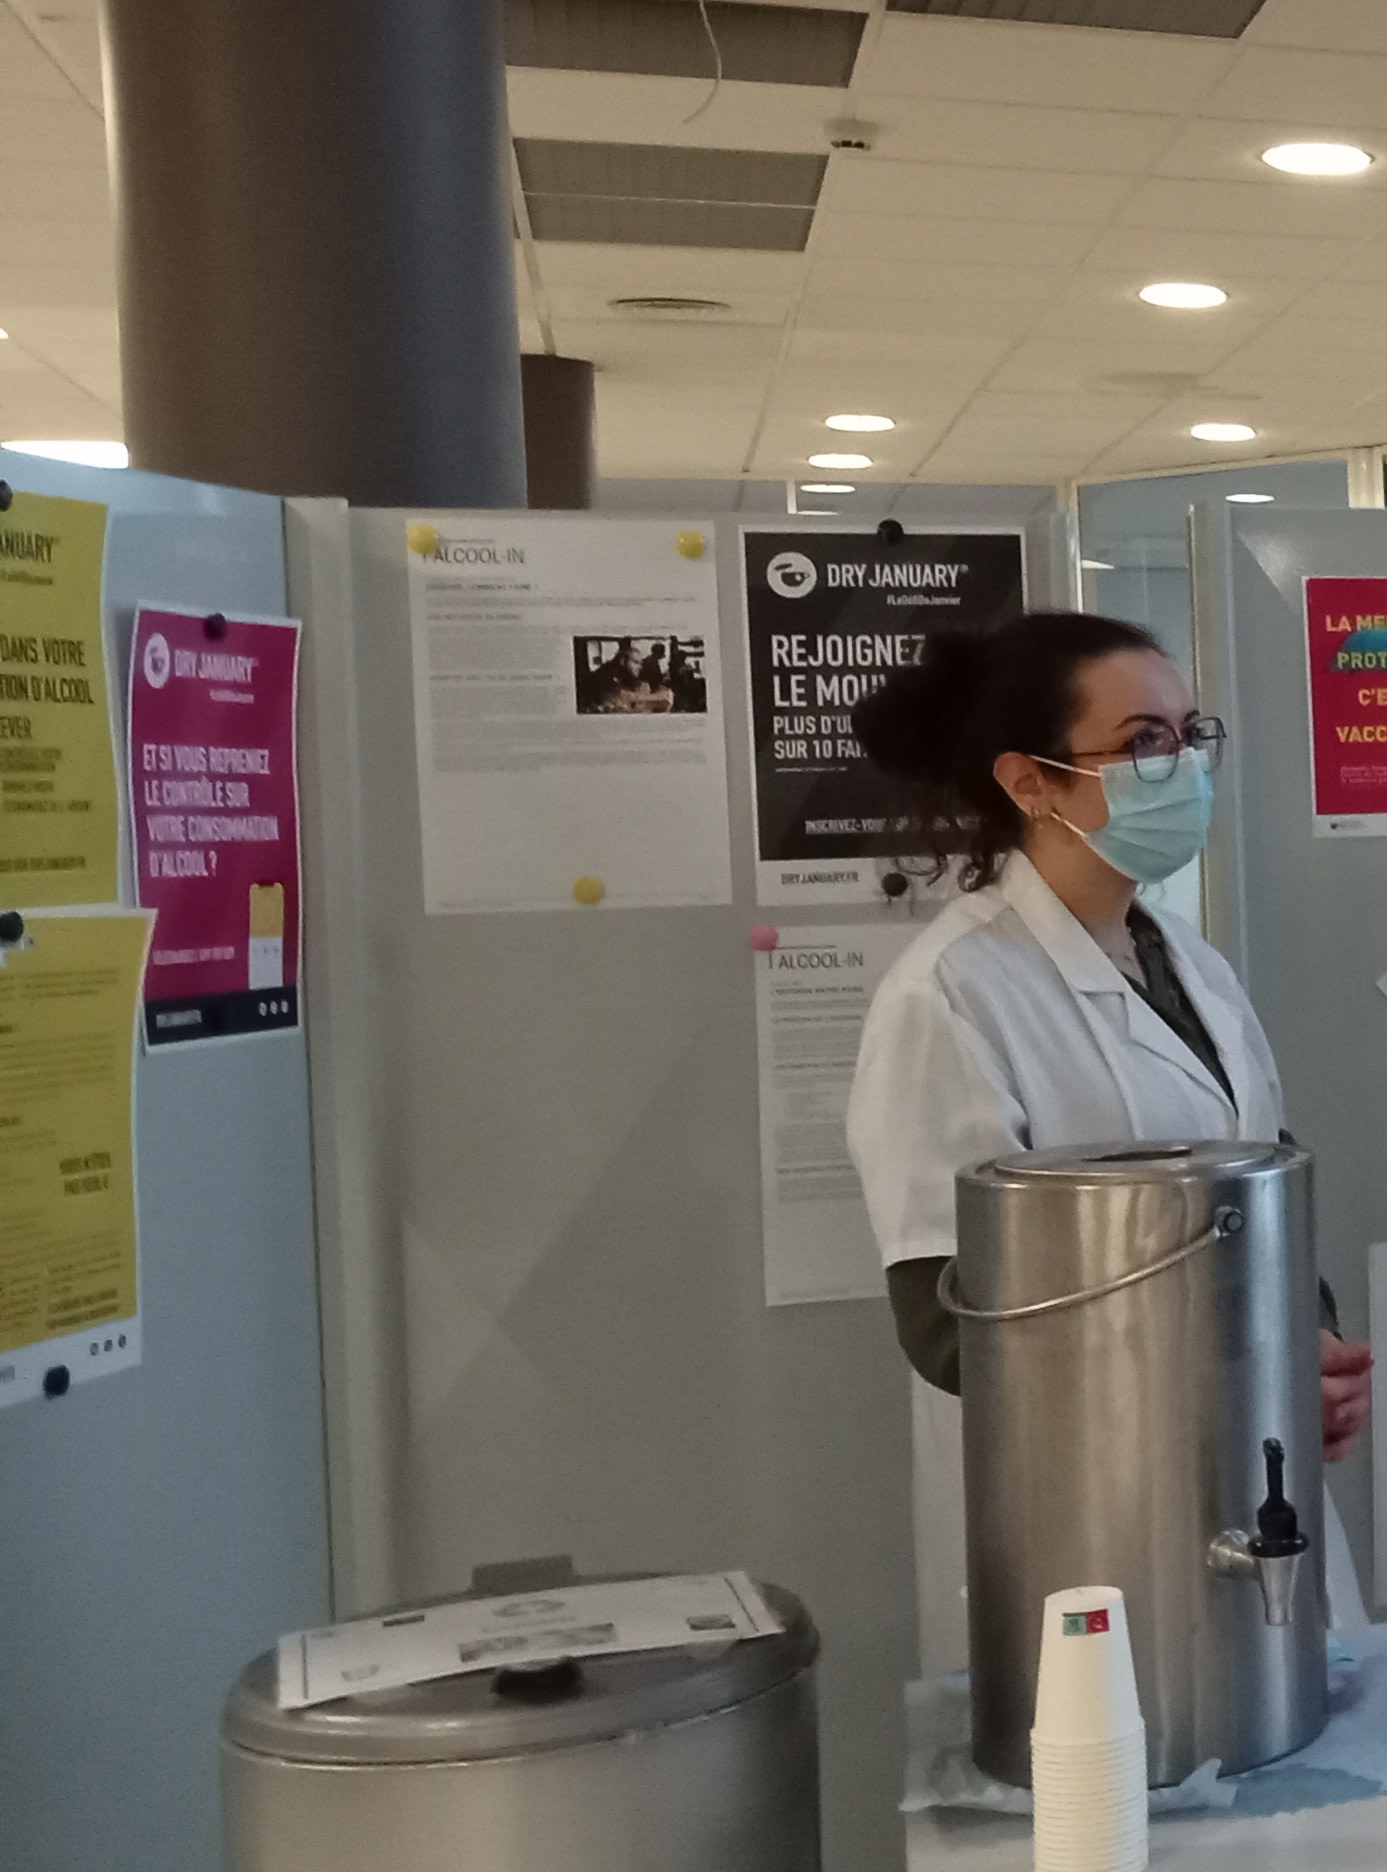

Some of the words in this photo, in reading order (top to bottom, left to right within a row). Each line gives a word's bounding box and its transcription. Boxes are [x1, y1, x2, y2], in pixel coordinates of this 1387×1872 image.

[827, 564, 866, 587] DRY
[1325, 614, 1352, 632] LA
[42, 637, 86, 667] VOTRE
[771, 633, 926, 667] REJOIGNEZ
[31, 675, 95, 705] D'ALCOOL
[773, 674, 808, 707] LE
[816, 674, 888, 707] MOU
[773, 715, 817, 735] PLUS
[174, 745, 208, 773] VOUS
[774, 739, 809, 760] SUR
[813, 739, 833, 759] 10
